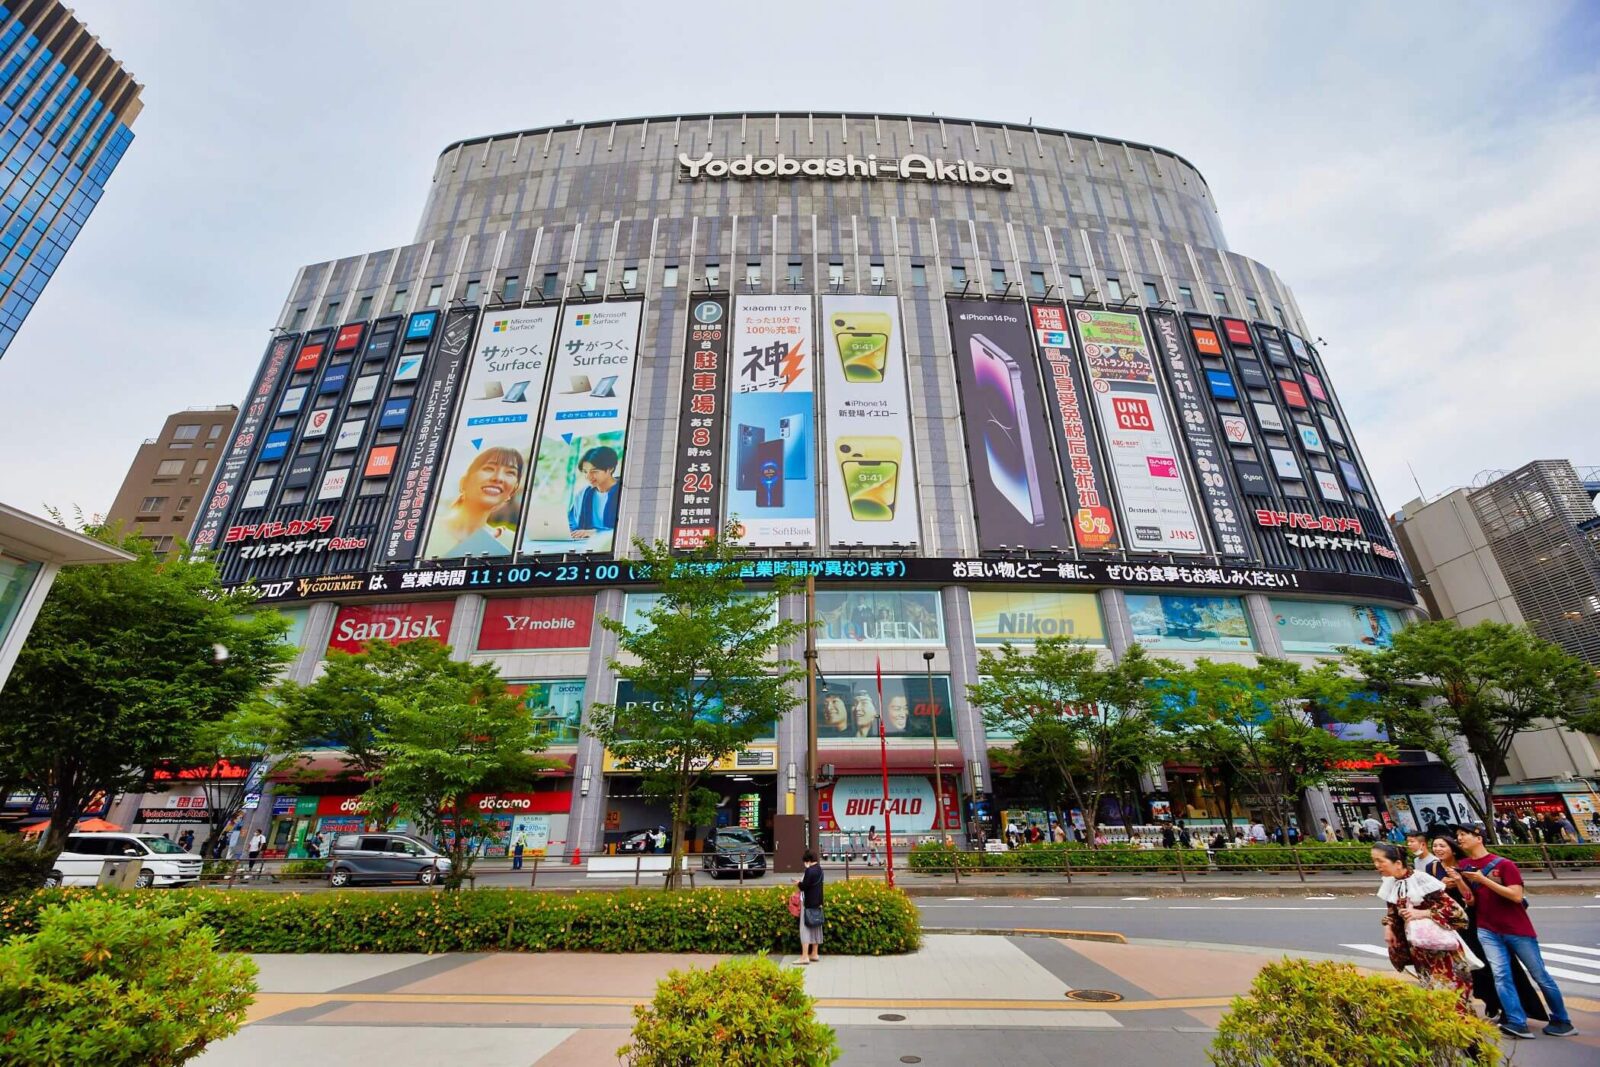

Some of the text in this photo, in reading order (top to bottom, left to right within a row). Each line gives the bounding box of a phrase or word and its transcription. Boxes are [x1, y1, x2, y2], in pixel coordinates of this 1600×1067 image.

[678, 151, 1015, 186] Yodobashi-Akiba
[702, 304, 717, 320] P
[967, 313, 994, 321] iPhone
[1004, 315, 1017, 323] Pro
[510, 317, 543, 325] Microsoft
[692, 330, 722, 341] 520
[1198, 337, 1217, 346] au
[488, 359, 541, 372] Surface
[573, 354, 628, 366] Surface
[741, 340, 789, 382] 神
[691, 351, 717, 414] 駐車場
[1174, 379, 1194, 393] 11
[690, 418, 713, 427] あさ
[692, 427, 711, 446] 8
[687, 463, 711, 472] よる
[683, 473, 713, 493] 24
[858, 474, 884, 482] 9:41
[1213, 507, 1235, 523] 22
[1256, 510, 1362, 534] ヨドバシカメラ
[226, 516, 334, 543] ヨドバシカメラ
[772, 527, 813, 536] SoftBank
[240, 536, 367, 560] マルチメディア Akiba
[1285, 533, 1370, 554] マルチメディア
[401, 570, 467, 590] 営業時間
[336, 615, 442, 642] SanDisk
[998, 612, 1075, 634] Nikon
[1290, 617, 1321, 629] Google
[479, 796, 531, 809] docomo
[845, 798, 922, 815] BUFFALO
